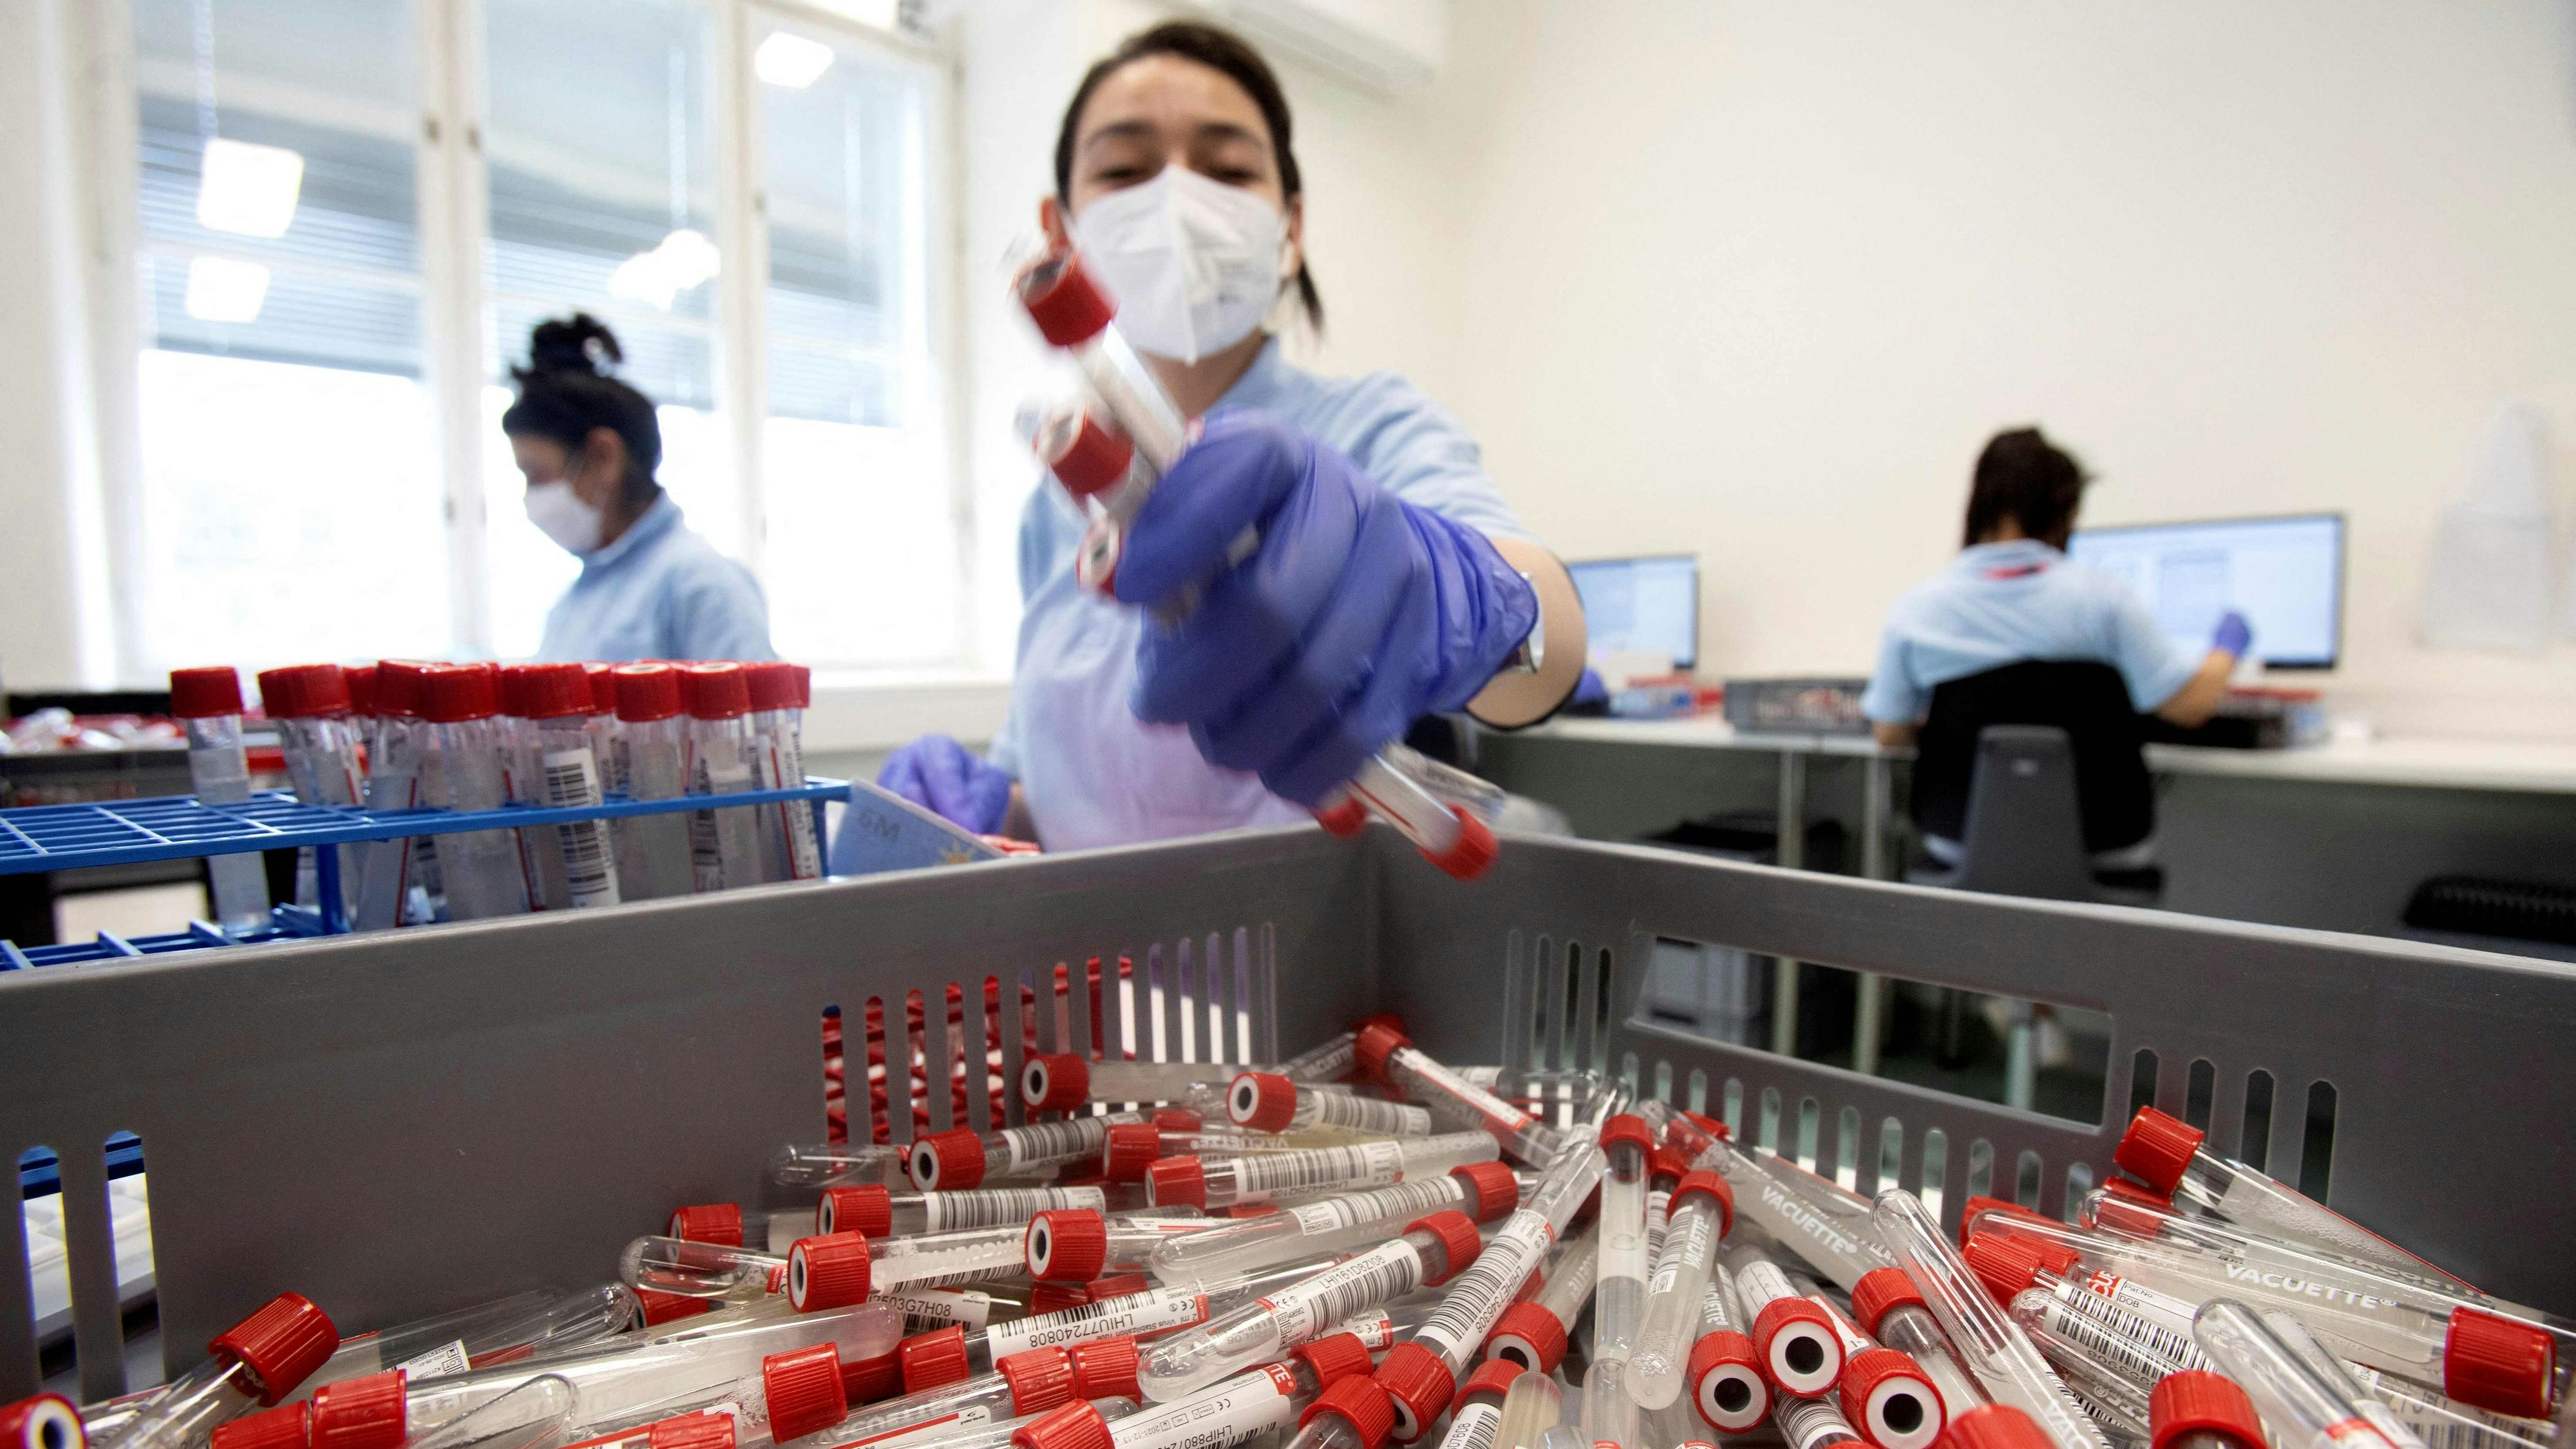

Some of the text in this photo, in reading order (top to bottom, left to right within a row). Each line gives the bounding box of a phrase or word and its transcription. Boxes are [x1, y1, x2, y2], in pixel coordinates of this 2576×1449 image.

[2119, 1295, 2139, 1308] DOB
[1159, 1319, 1177, 1327] Virus
[1030, 1314, 1134, 1347] LHIU77240808
[1377, 1336, 1383, 1345] 2
[1232, 1371, 1264, 1387] Surname
